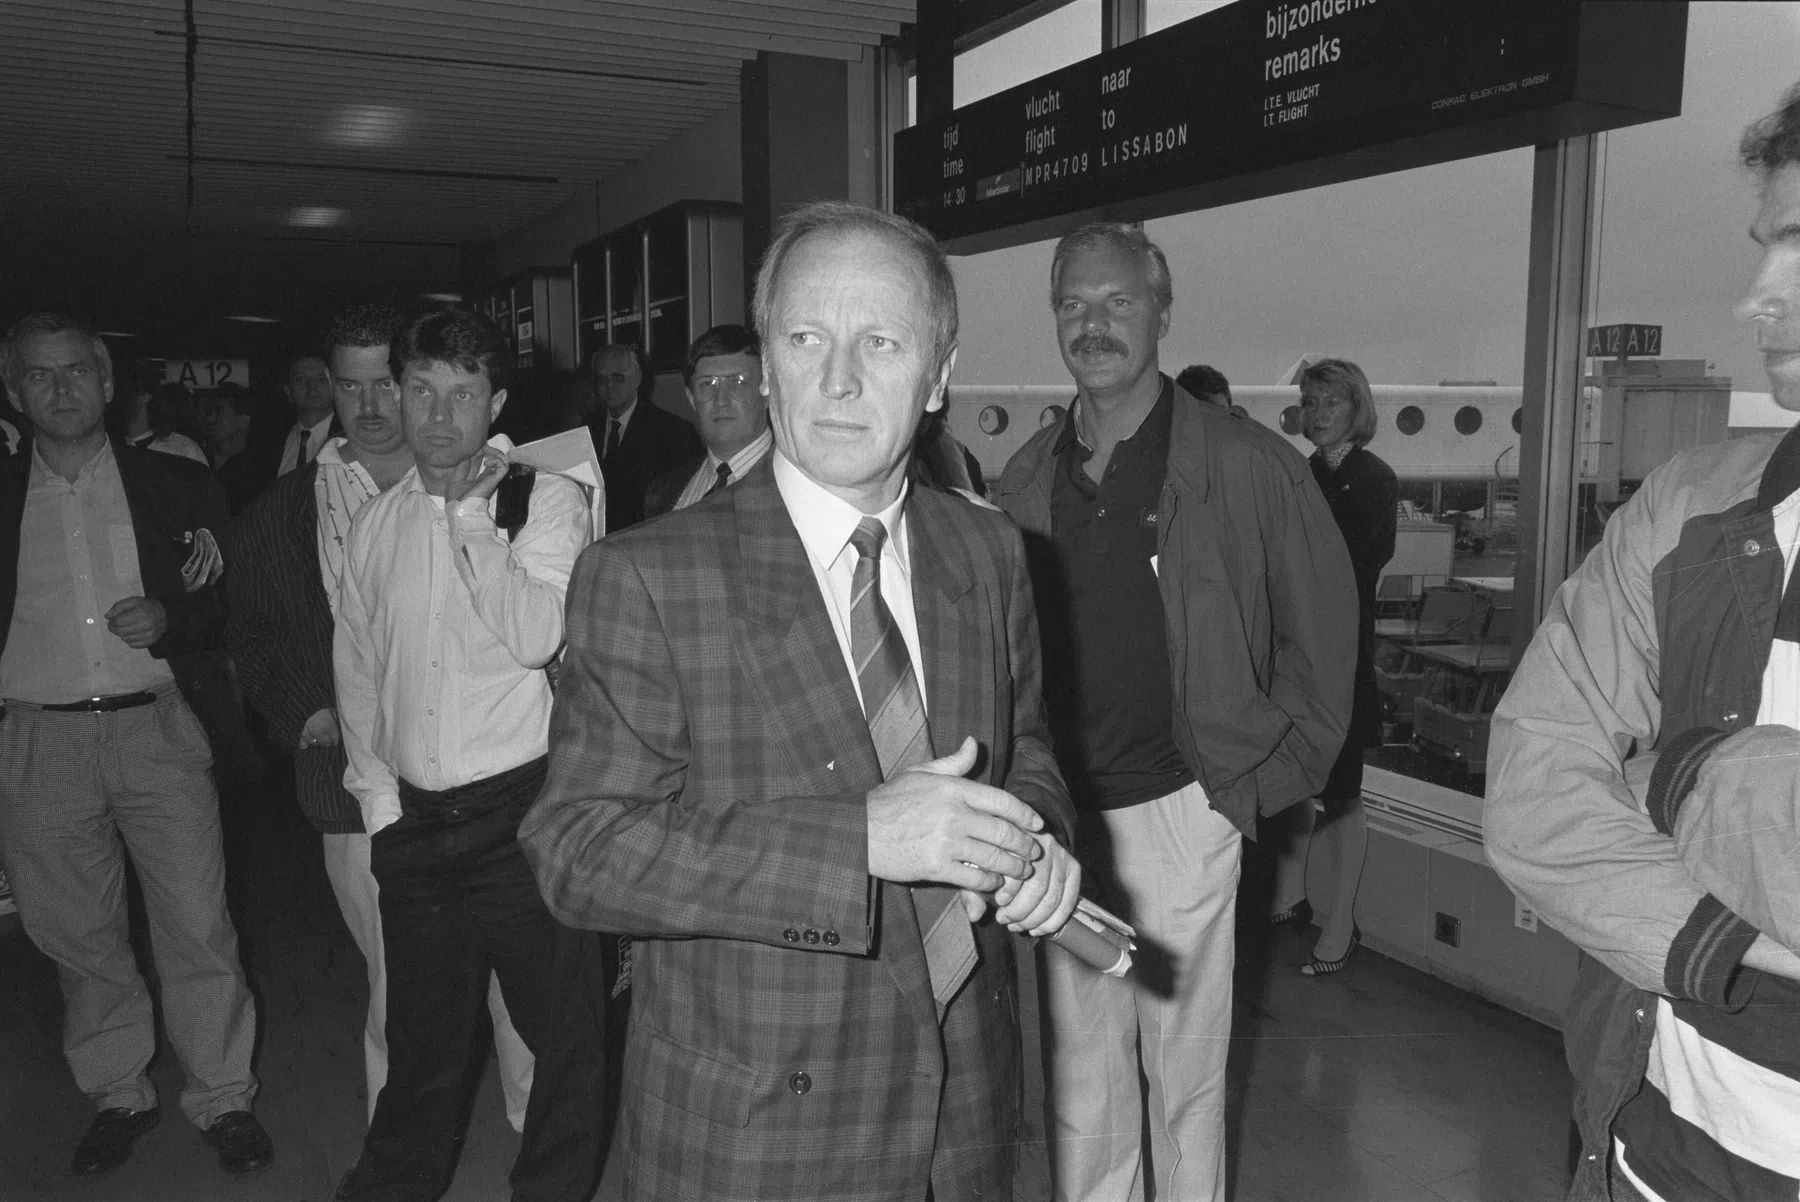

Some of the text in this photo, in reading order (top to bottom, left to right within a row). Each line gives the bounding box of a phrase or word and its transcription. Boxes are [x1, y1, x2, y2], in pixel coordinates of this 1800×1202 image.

[1266, 0, 1377, 39] bijzonde
[1265, 35, 1341, 81] remarks
[1102, 67, 1131, 95] naar
[1287, 83, 1320, 104] VLUCHT
[1025, 89, 1060, 119] vlucht
[1278, 104, 1308, 123] FLIGHT
[1102, 109, 1115, 130] to
[943, 124, 958, 151] tijd
[1025, 125, 1055, 154] flight
[1025, 123, 1187, 186] MPR4709 LISSABON
[943, 158, 963, 179] time
[1590, 327, 1621, 354] A 12
[1627, 327, 1658, 353] A 12
[180, 361, 232, 385] A 12
